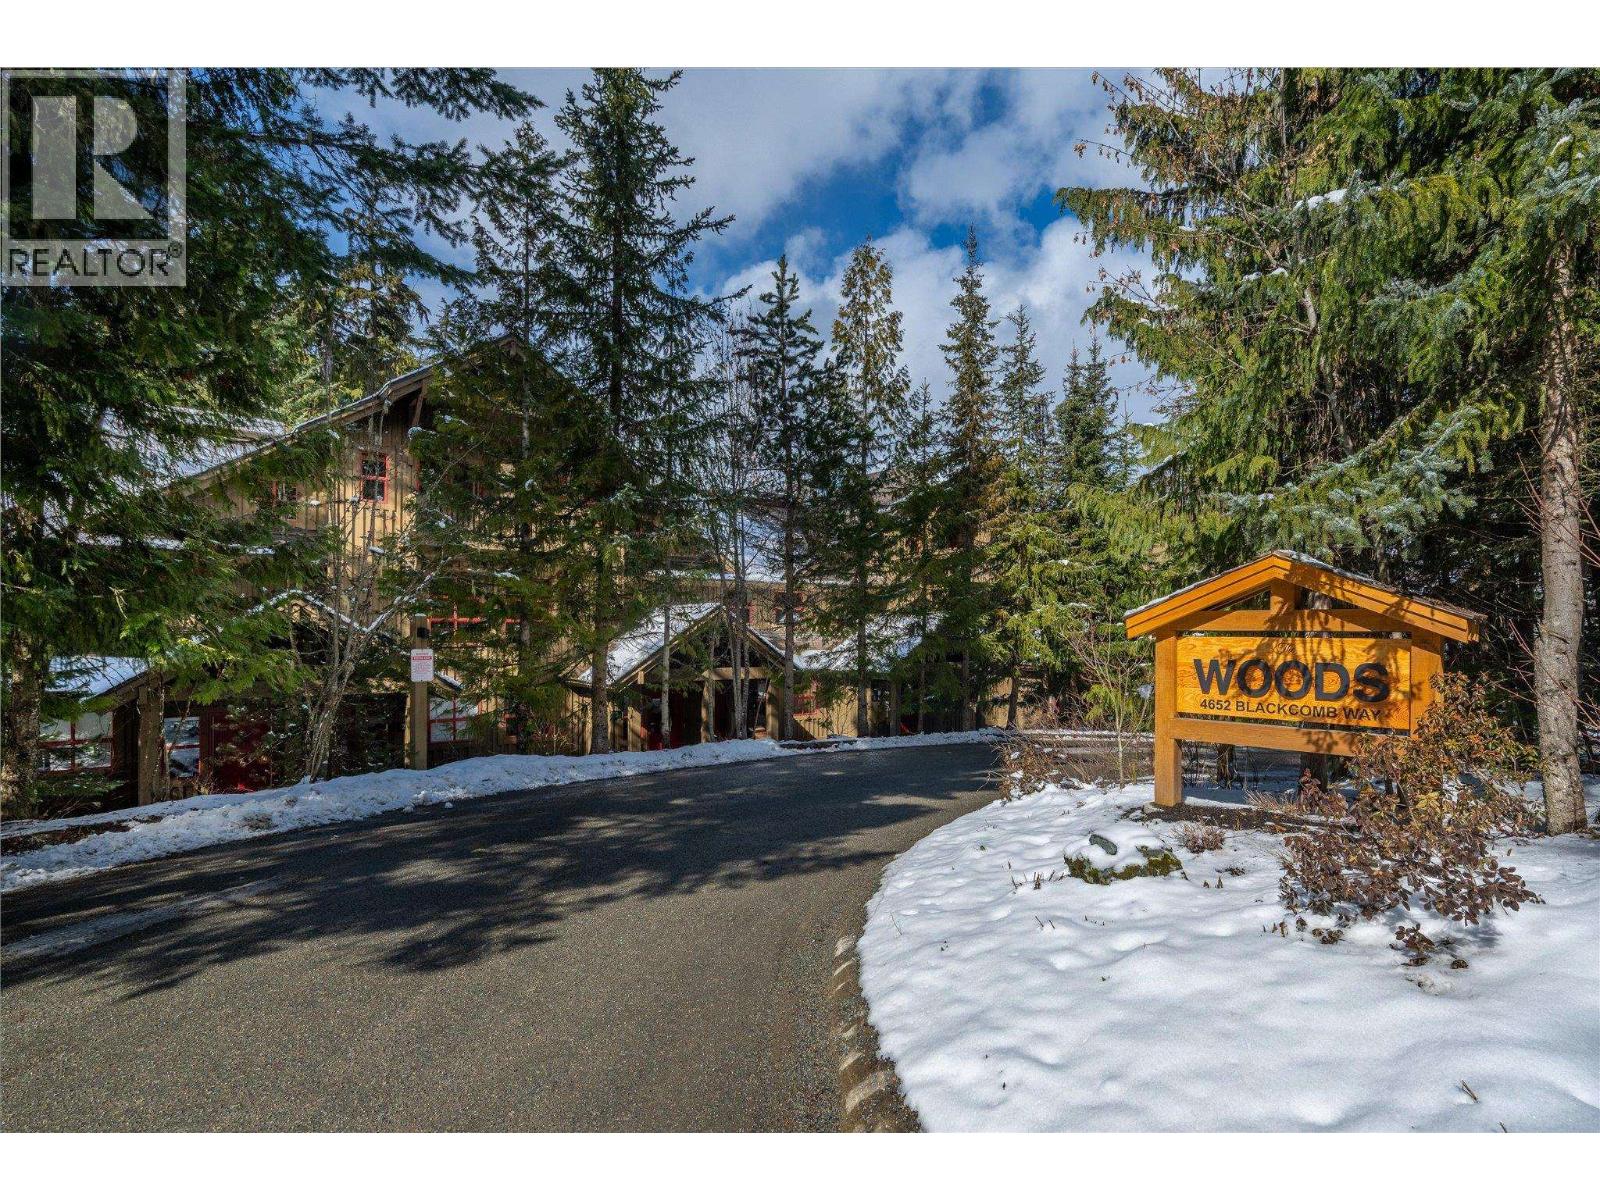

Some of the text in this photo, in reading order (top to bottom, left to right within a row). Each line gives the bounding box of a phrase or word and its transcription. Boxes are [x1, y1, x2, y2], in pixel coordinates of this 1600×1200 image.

[1194, 658, 1390, 703] WOODS
[1200, 699, 1382, 720] 4652 BLACKCOMB WAY
